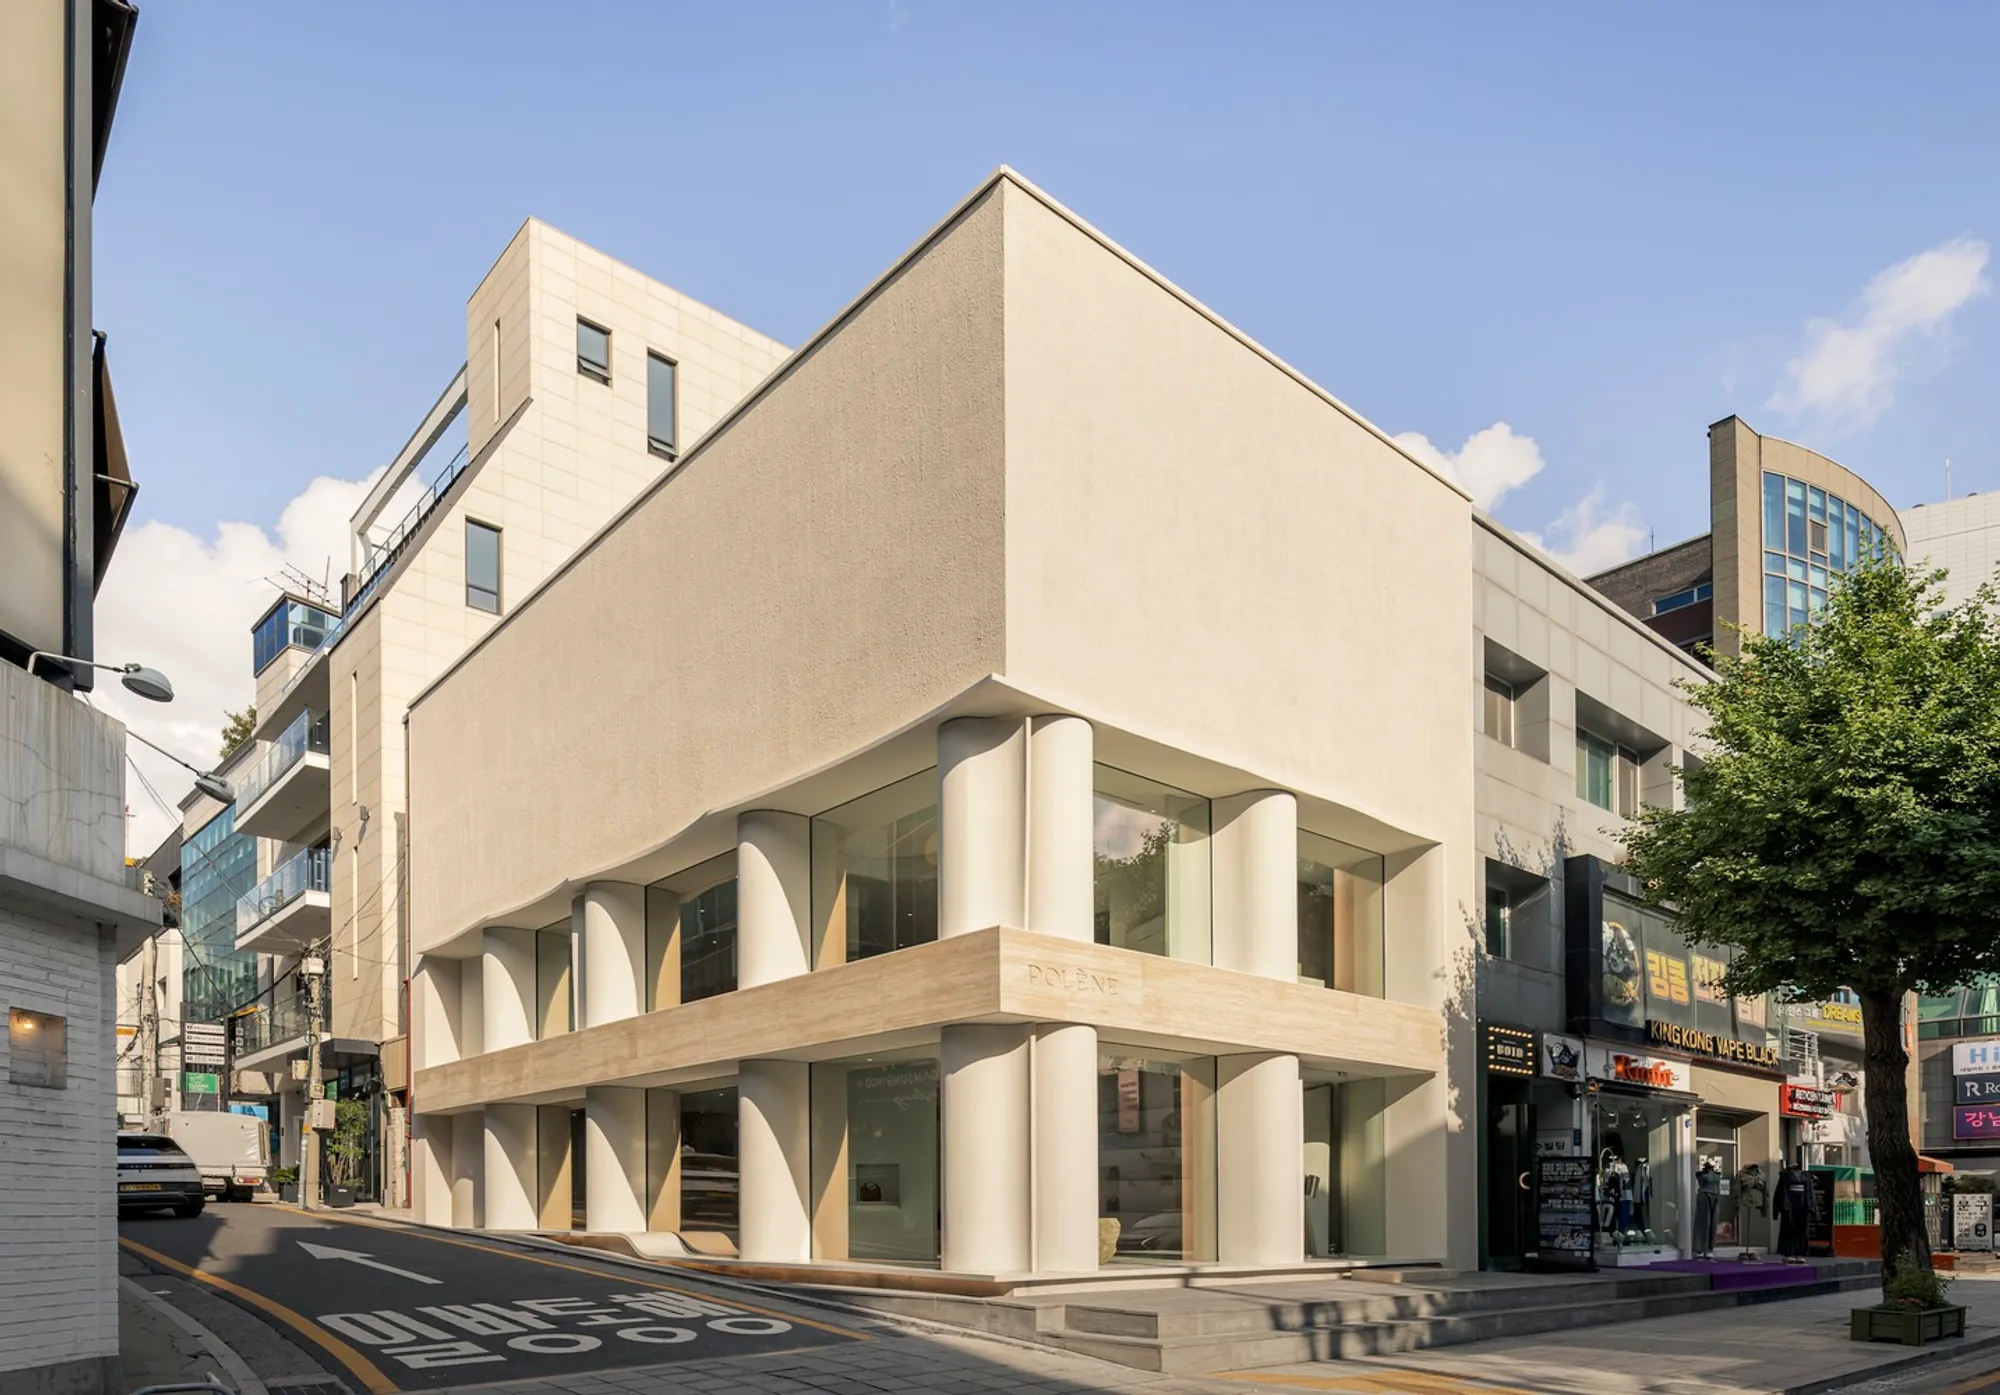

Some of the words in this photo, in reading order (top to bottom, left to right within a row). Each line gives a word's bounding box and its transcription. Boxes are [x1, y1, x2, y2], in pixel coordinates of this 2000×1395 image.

[1646, 948, 1690, 1005] 킹콩
[1715, 1036, 1745, 1060] VAPE
[1746, 1042, 1780, 1066] BLACK
